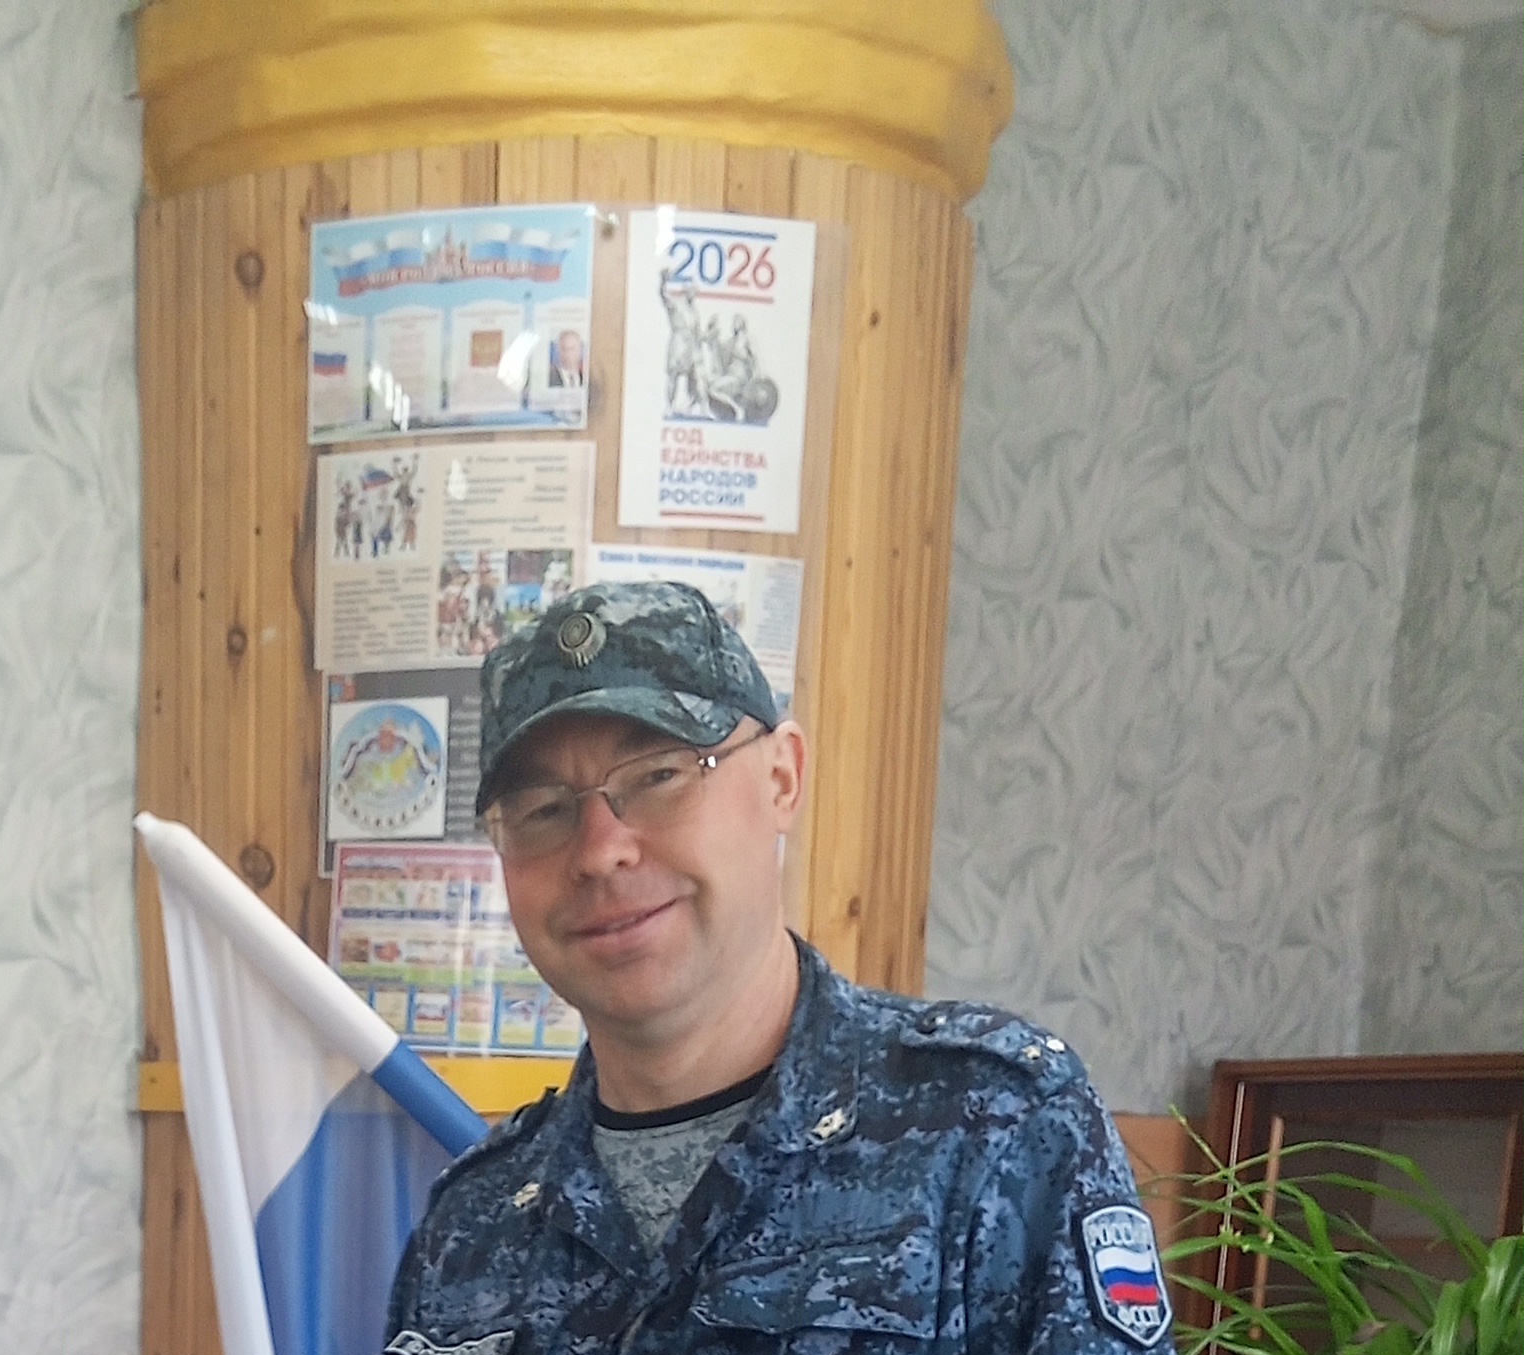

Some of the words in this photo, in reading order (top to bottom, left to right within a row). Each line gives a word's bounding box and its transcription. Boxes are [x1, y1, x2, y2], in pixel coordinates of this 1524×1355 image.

[668, 238, 775, 290] 2026
[661, 427, 703, 446] ГОД
[660, 447, 768, 470] ЕДИНСТВА
[659, 469, 758, 489] НАРОДОВ
[659, 488, 745, 508] РОССИИ
